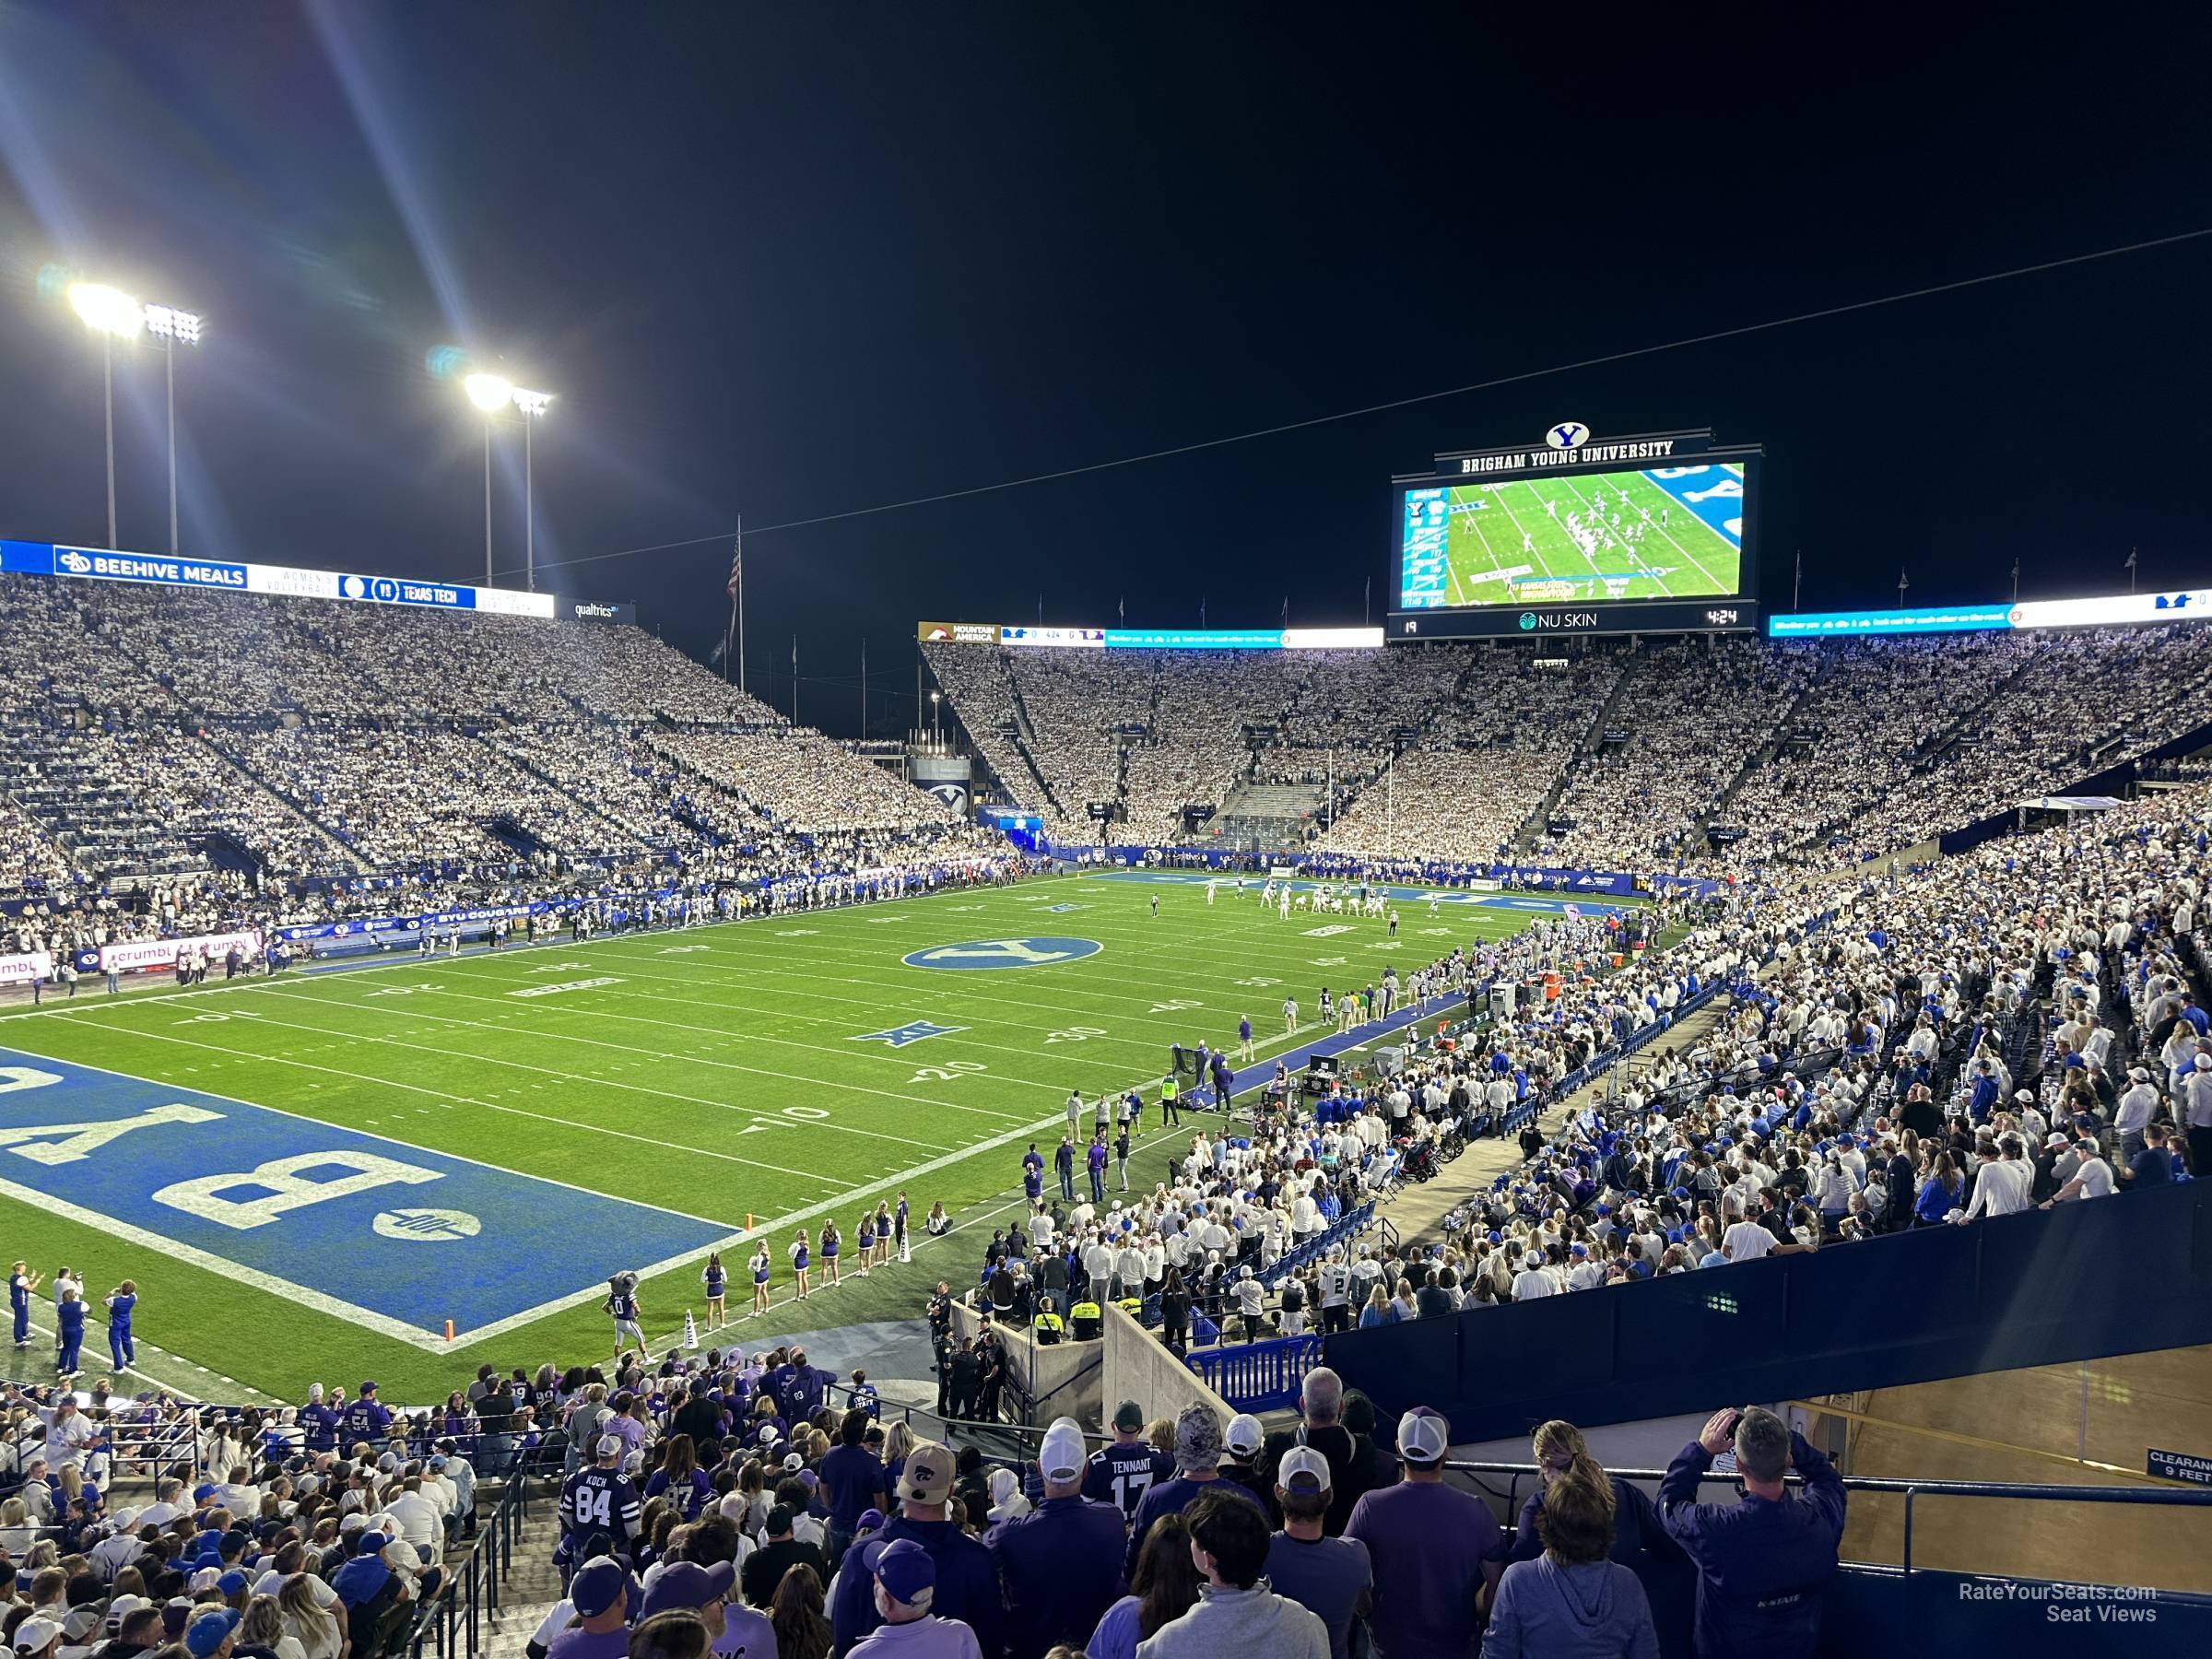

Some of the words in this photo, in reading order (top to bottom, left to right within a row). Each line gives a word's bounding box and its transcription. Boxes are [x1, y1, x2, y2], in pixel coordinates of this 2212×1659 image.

[1553, 425, 1582, 446] Y
[1462, 453, 1525, 473] BRIGHAM
[1530, 450, 1577, 466] YOUNG
[1583, 441, 1674, 462] UNIVERSITY
[94, 557, 179, 579] BEEHIVE
[184, 565, 244, 585] MEALS
[404, 585, 433, 601] TEXAS
[434, 590, 457, 604] TECH
[574, 603, 612, 618] qualtrics
[1708, 610, 1737, 623] 4:24
[1406, 621, 1417, 633] 19
[1538, 615, 1560, 628] NU
[1564, 613, 1597, 627] SKIN
[953, 626, 995, 634] MOUNTAIN
[955, 633, 993, 641] AMERICA
[1636, 879, 1648, 890] 19
[438, 912, 466, 923] BYU
[468, 906, 530, 920] COUGARS
[118, 946, 171, 962] crumbl
[1156, 999, 1204, 1010] 40
[1047, 1027, 1108, 1041] 30
[915, 1061, 989, 1081] 20
[749, 1106, 830, 1128] 10
[1275, 1219, 1282, 1233] 5
[1335, 1277, 1344, 1295] 2
[614, 1300, 624, 1314] 0
[351, 1415, 371, 1431] 54
[1112, 1457, 1151, 1474] TENNANT
[2150, 1452, 2212, 1471] CLEARAN
[586, 1475, 607, 1488] KOCH
[2166, 1465, 2174, 1476] 9
[2179, 1468, 2212, 1482] FEET
[1111, 1472, 1154, 1521] 17
[575, 1486, 611, 1526] 84
[1757, 1593, 1802, 1608] K-STATE
